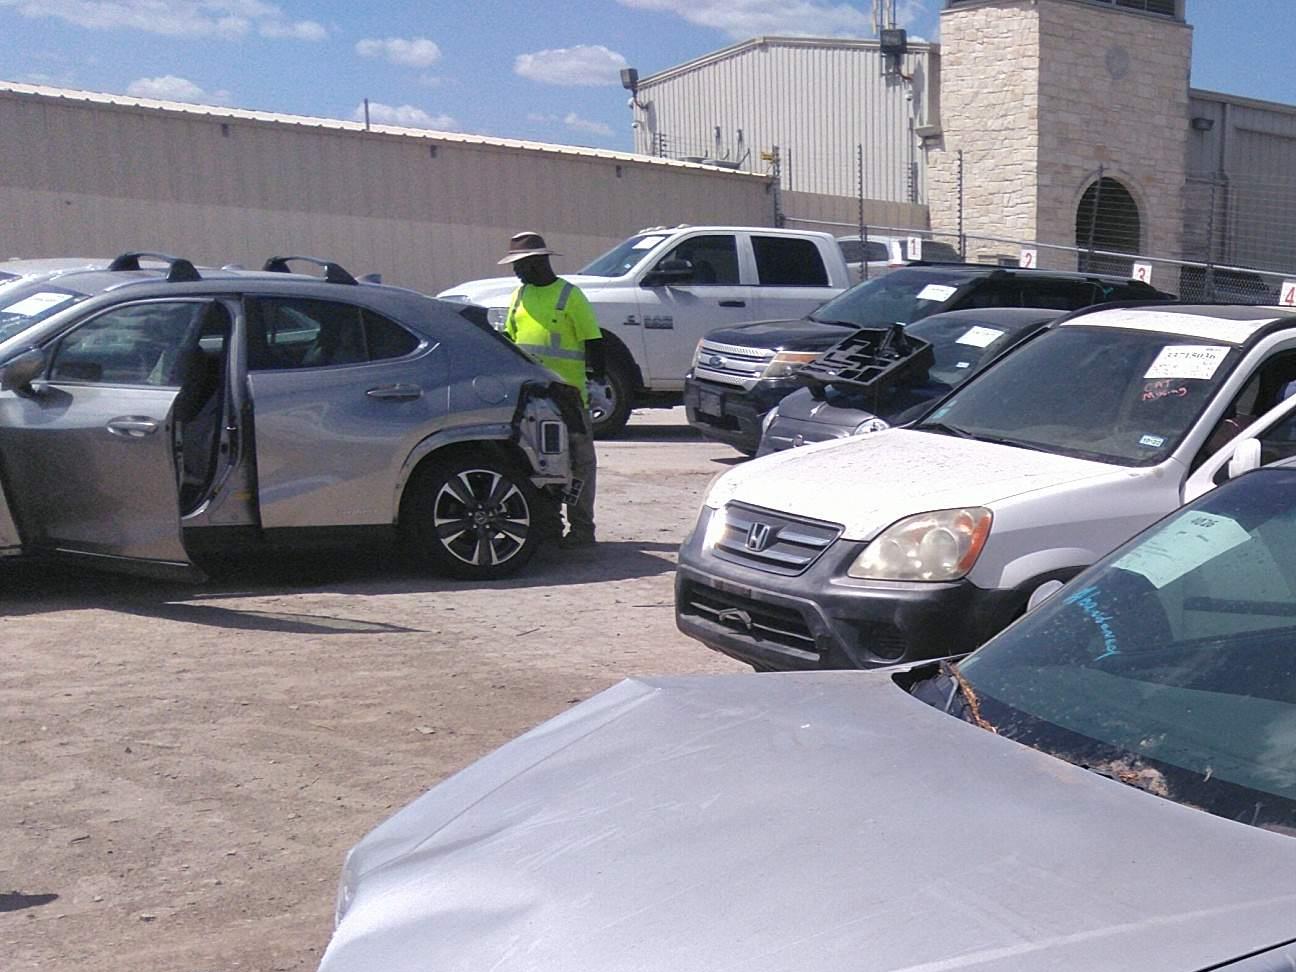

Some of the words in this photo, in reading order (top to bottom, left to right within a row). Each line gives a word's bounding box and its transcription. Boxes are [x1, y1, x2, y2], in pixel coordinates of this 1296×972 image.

[910, 238, 917, 256] 1
[1023, 253, 1033, 268] 2
[1137, 268, 1147, 282] 3
[1285, 287, 1295, 304] 4
